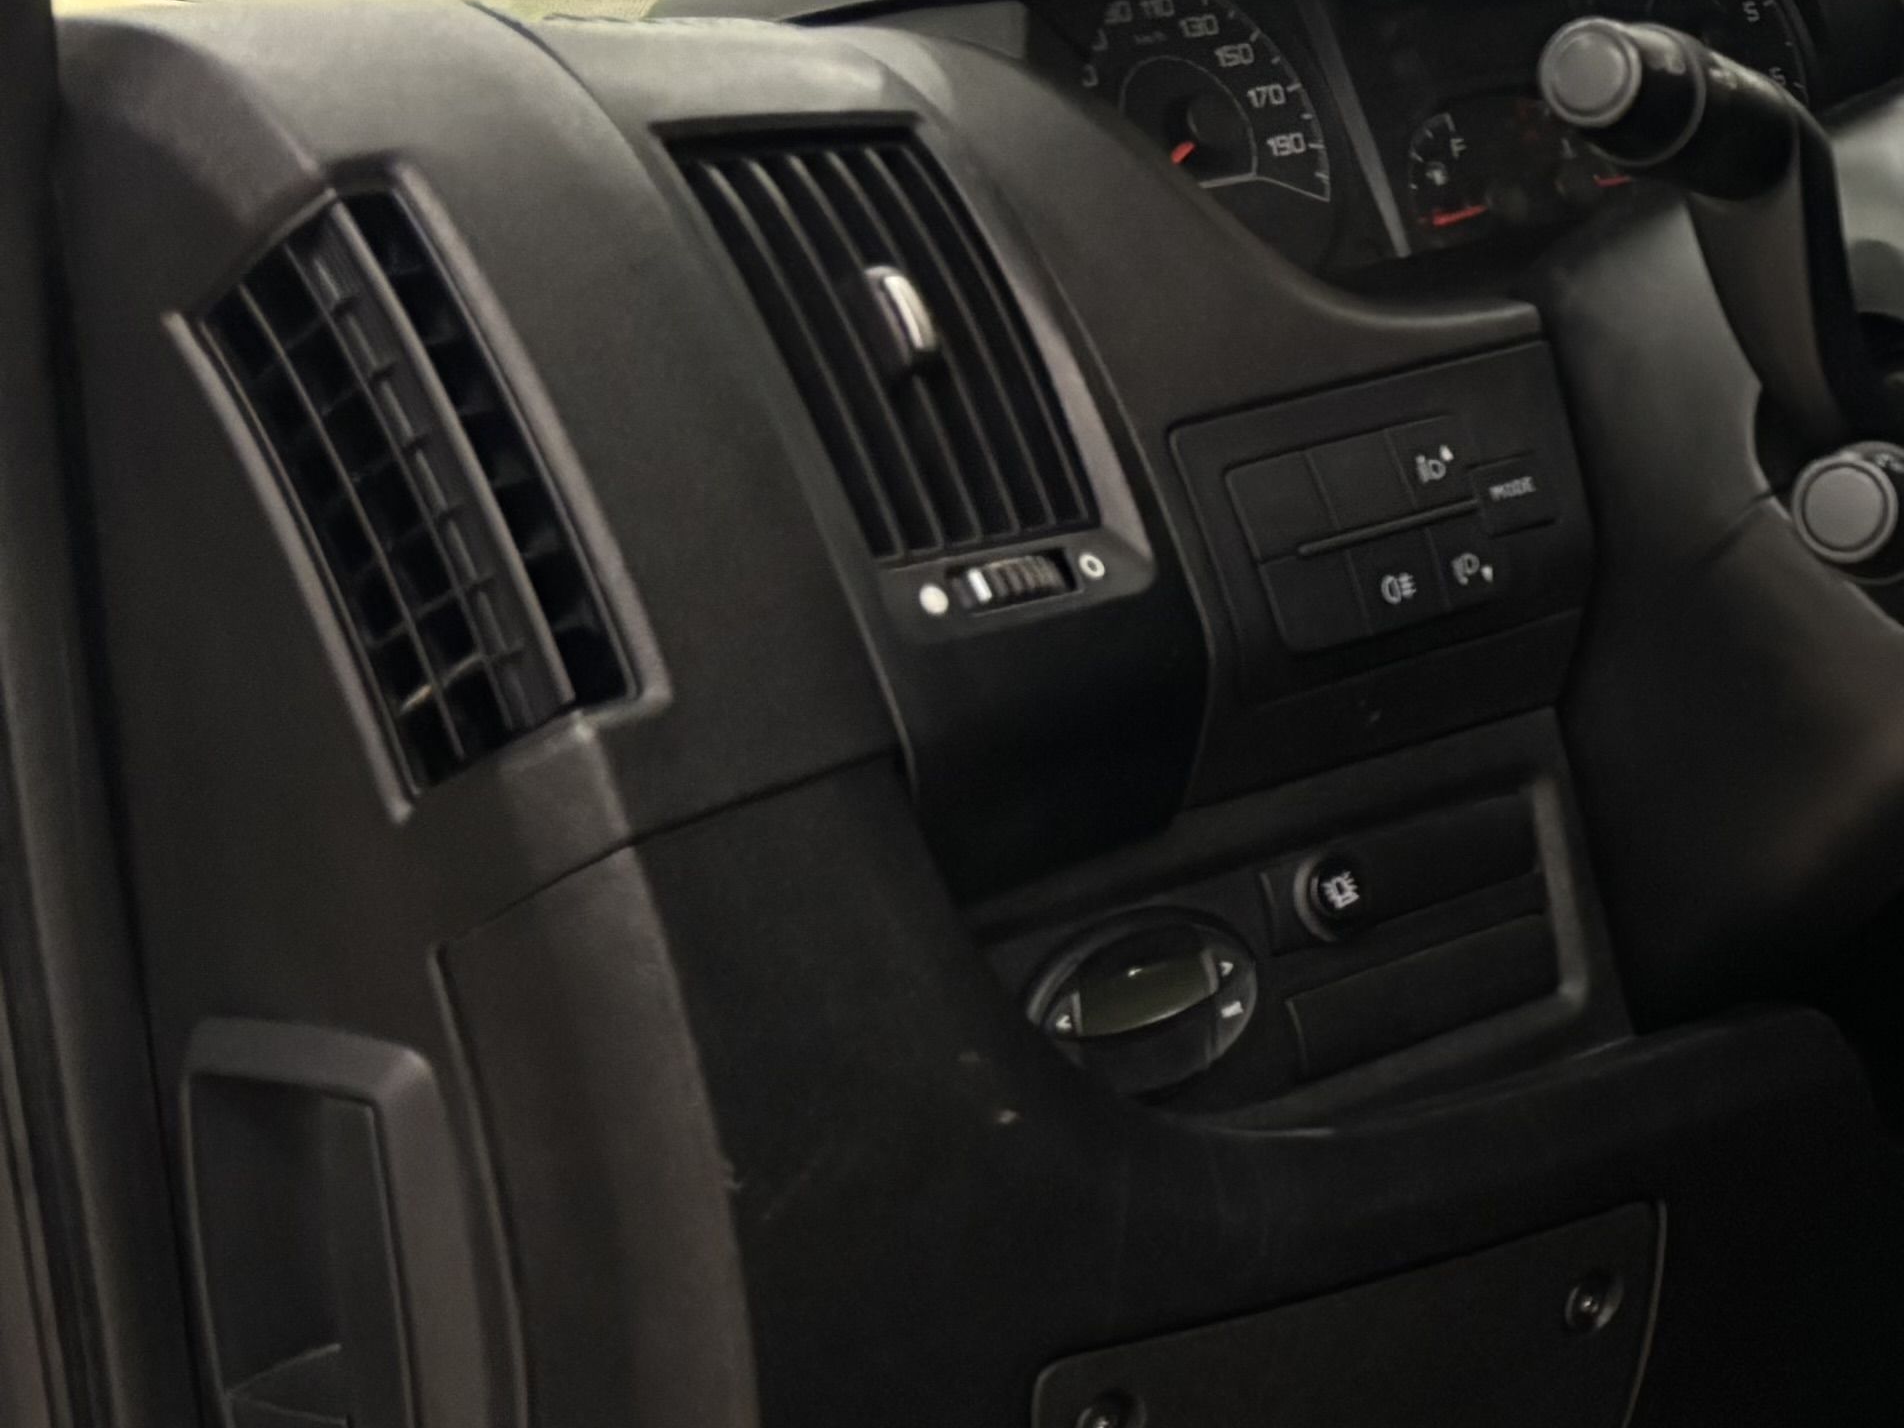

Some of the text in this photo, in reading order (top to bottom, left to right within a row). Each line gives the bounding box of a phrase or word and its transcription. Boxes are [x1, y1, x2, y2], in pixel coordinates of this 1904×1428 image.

[1742, 0, 1760, 23] 5
[1179, 13, 1220, 39] 130
[1214, 42, 1255, 68] 150
[1247, 82, 1287, 109] 170
[1266, 131, 1306, 157] 190
